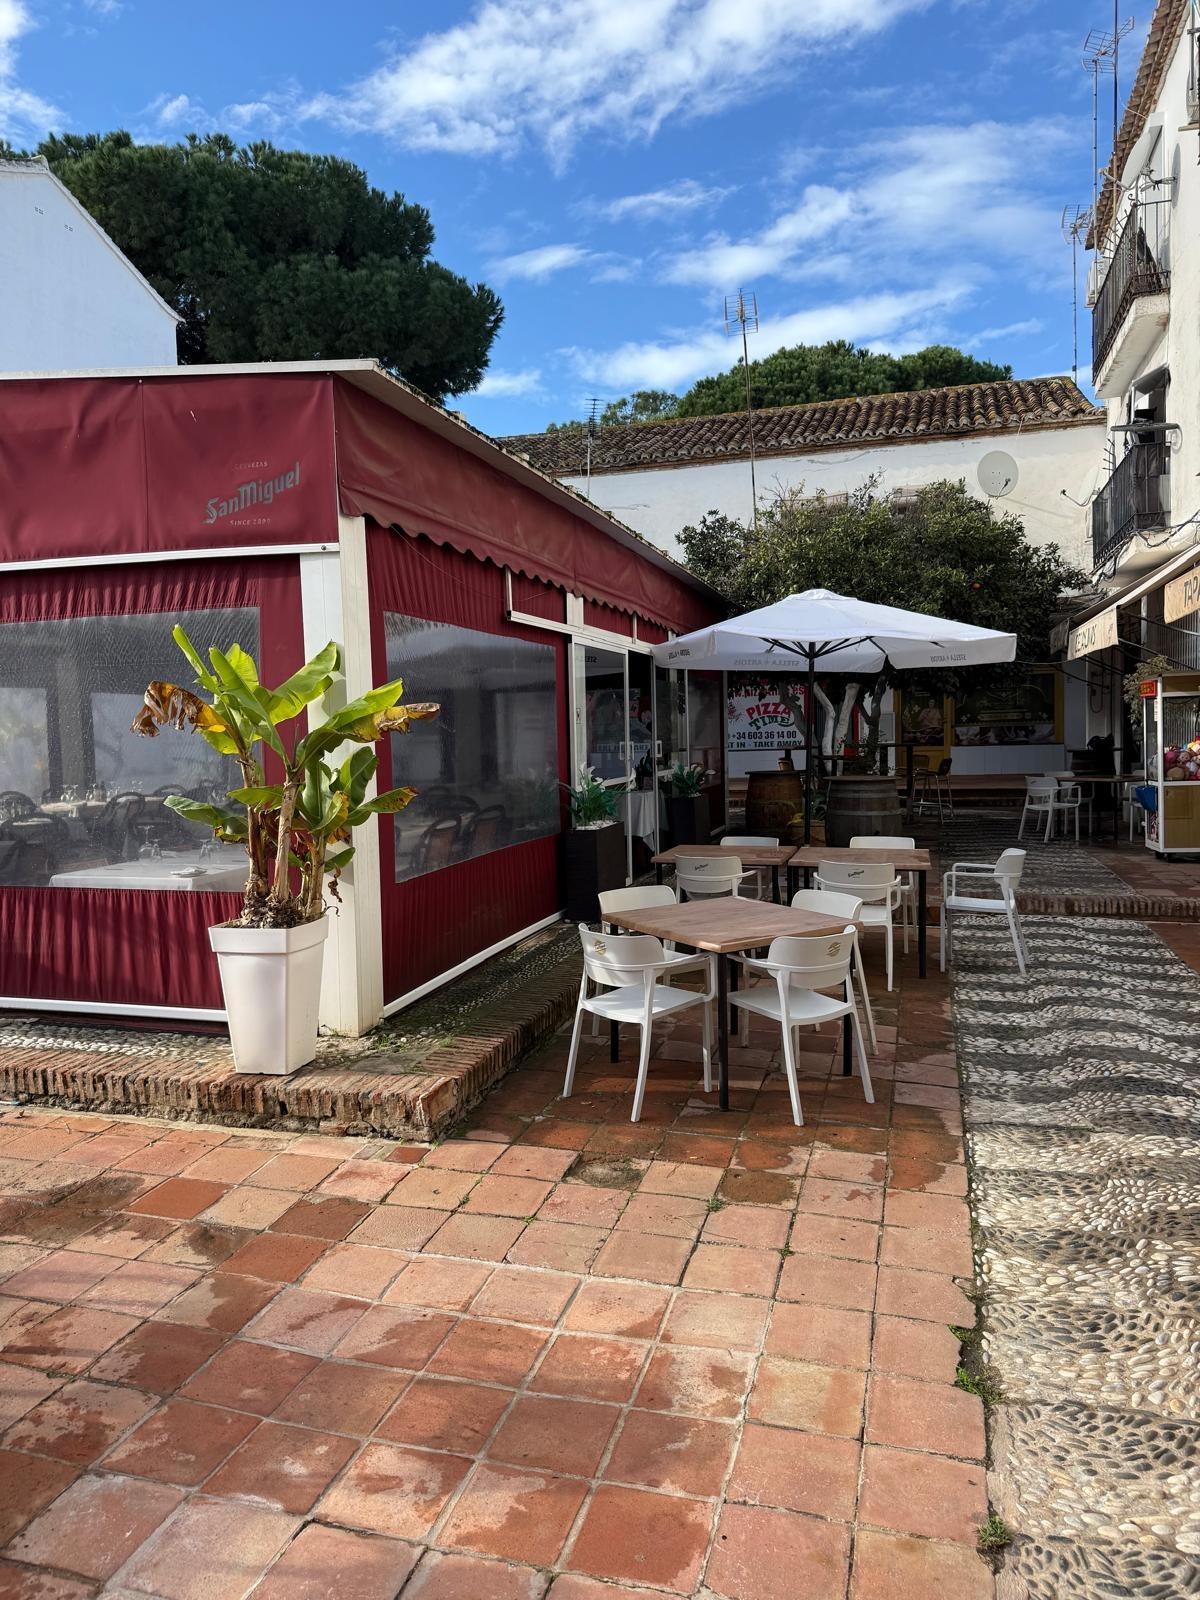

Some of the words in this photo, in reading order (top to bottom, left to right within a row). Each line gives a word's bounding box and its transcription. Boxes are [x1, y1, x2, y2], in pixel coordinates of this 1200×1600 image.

[1184, 575, 1200, 608] TAP
[745, 702, 792, 720] PIZZA
[749, 715, 794, 730] TIME
[747, 731, 763, 740] 603
[764, 731, 775, 740] 36
[776, 731, 785, 740] 14
[786, 730, 797, 739] 00
